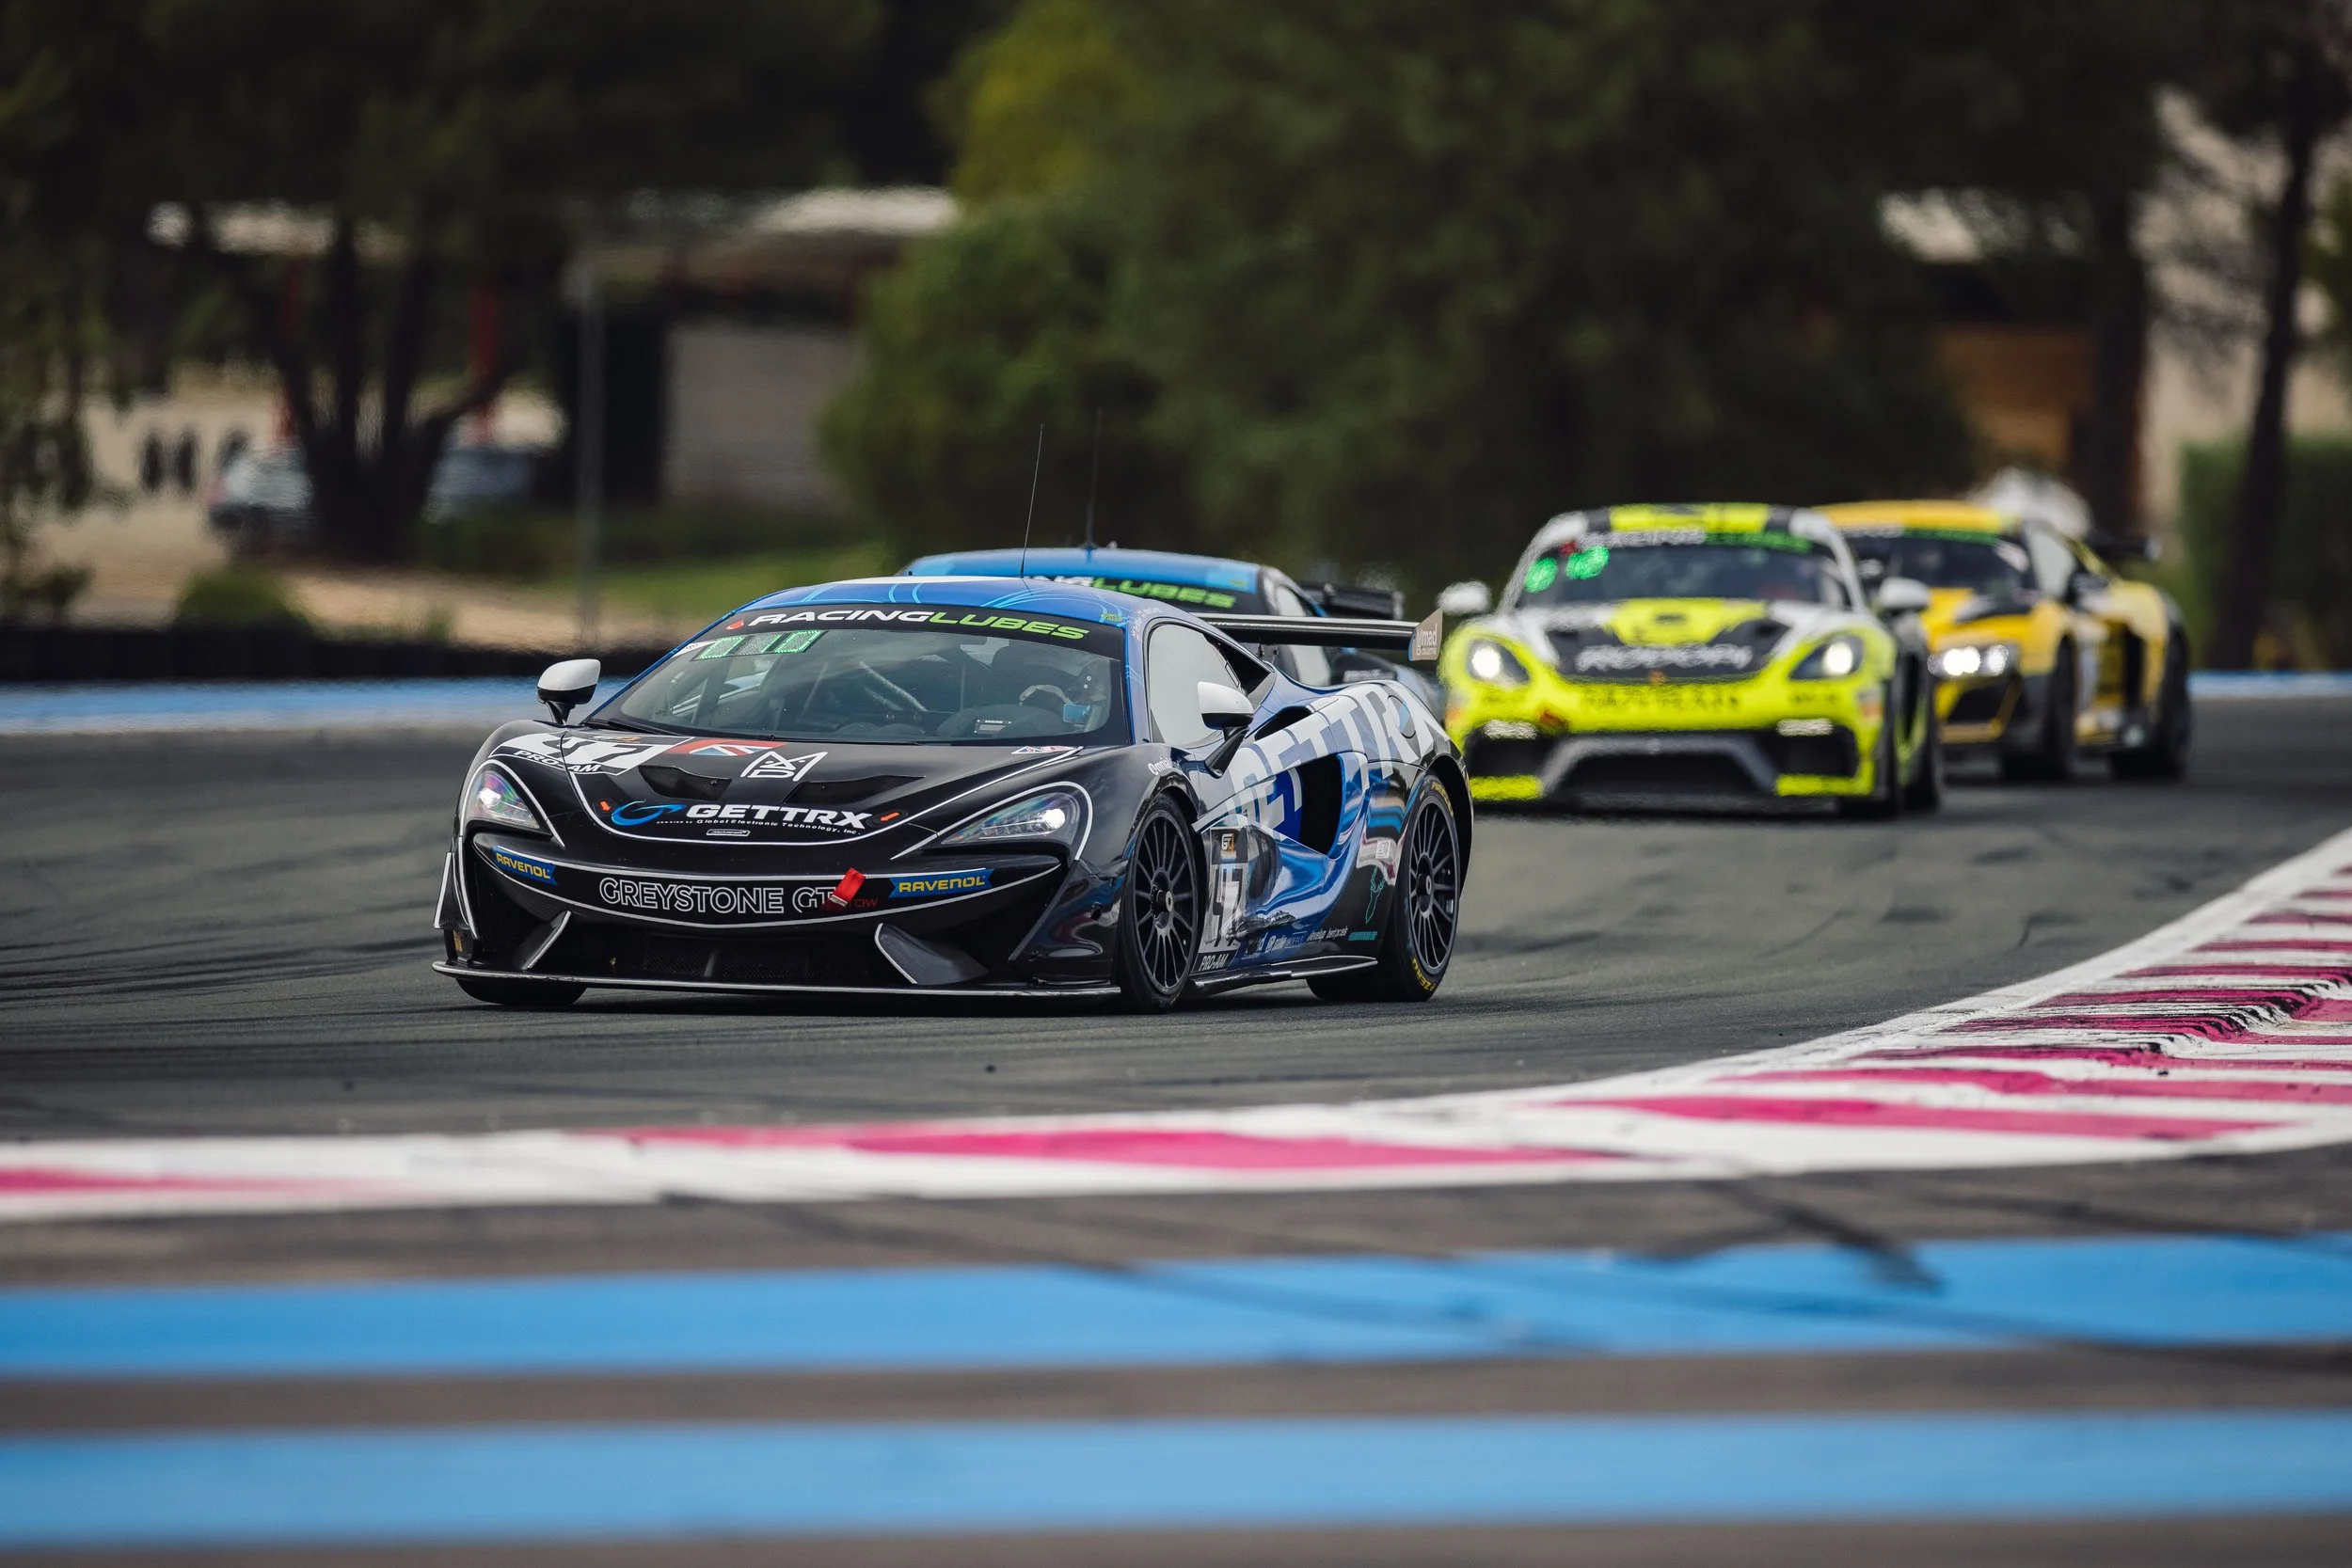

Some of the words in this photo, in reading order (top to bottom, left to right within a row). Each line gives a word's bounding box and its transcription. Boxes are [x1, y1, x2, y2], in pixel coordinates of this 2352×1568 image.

[748, 610, 1089, 640] RACINGLUBES
[514, 751, 601, 772] PRO-AM
[686, 804, 872, 829] GETTRX
[782, 823, 841, 833] Technology,
[496, 852, 550, 879] RAVENOL
[599, 877, 785, 914] GREYSTONE
[898, 876, 986, 893] RAVENOL
